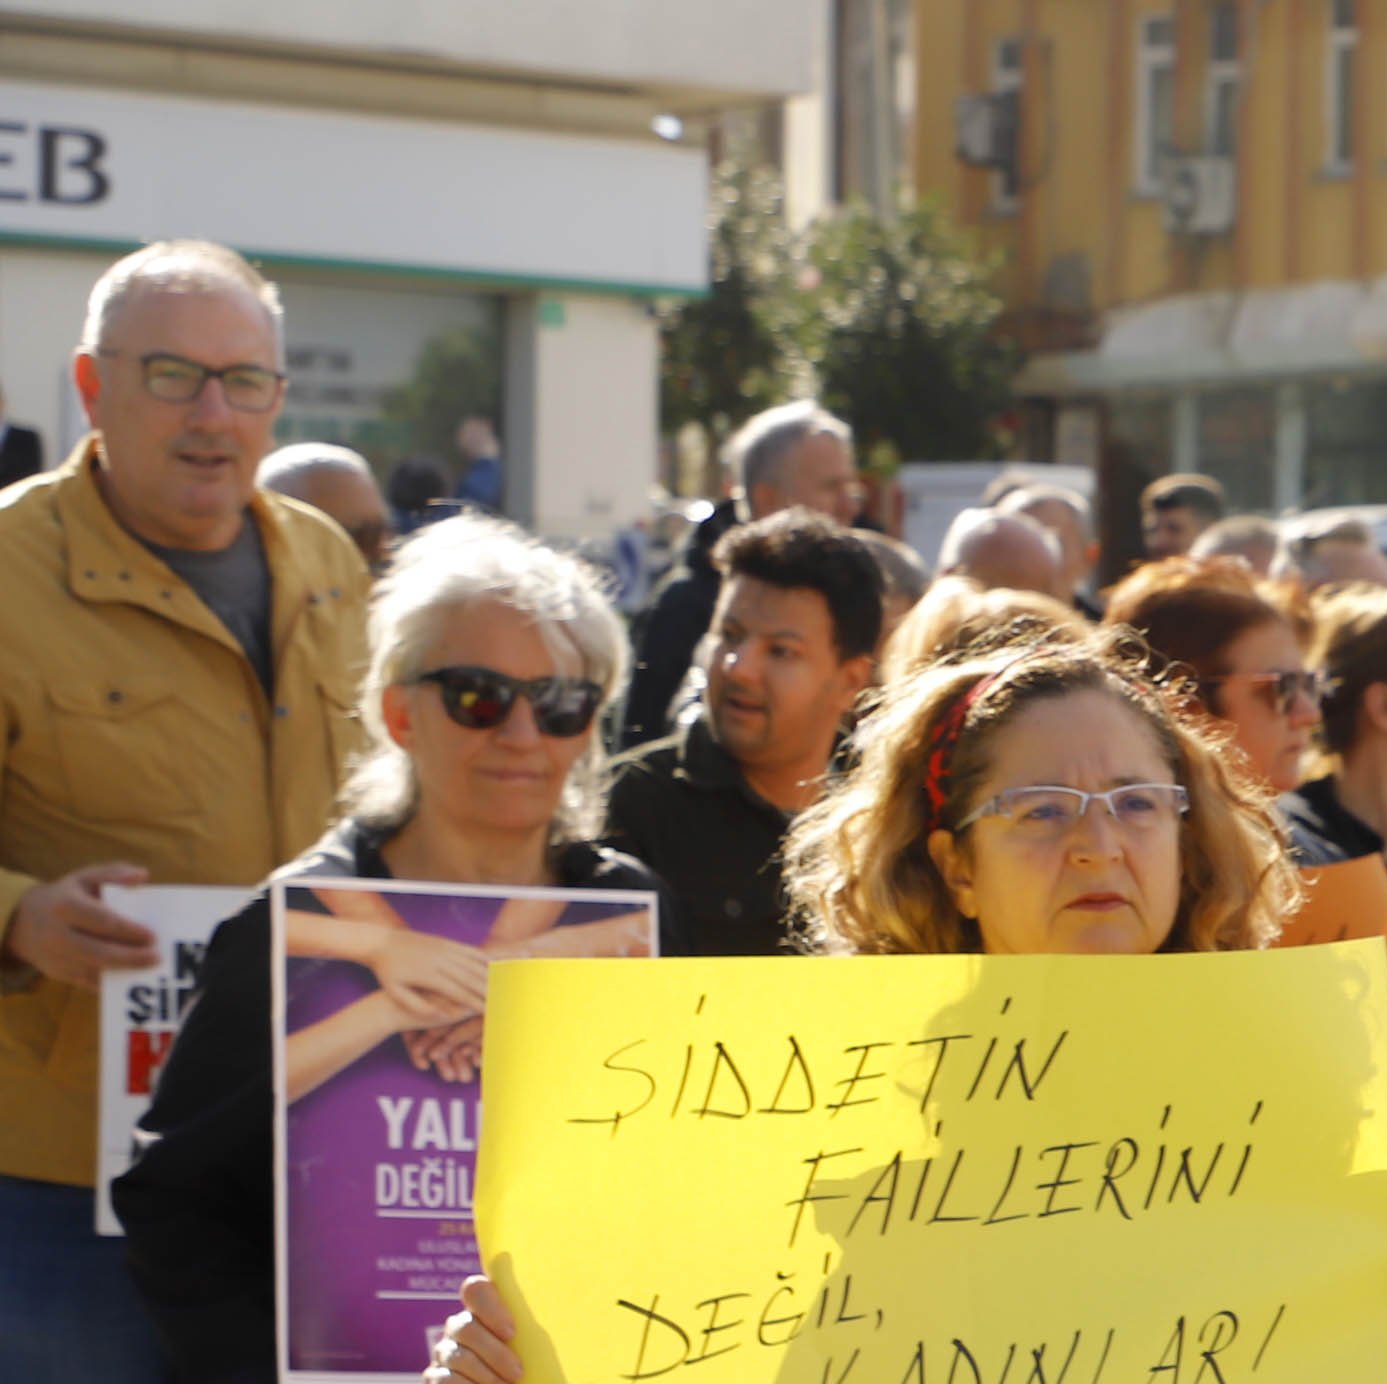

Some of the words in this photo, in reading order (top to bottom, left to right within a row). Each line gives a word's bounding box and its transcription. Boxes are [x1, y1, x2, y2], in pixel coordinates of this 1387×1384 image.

[376, 1095, 483, 1152] YAL
[567, 994, 1069, 1139] ŞİDDETİN
[785, 1100, 1264, 1249] FAİLLERİNİ
[616, 1252, 884, 1384] DEĞİL,
